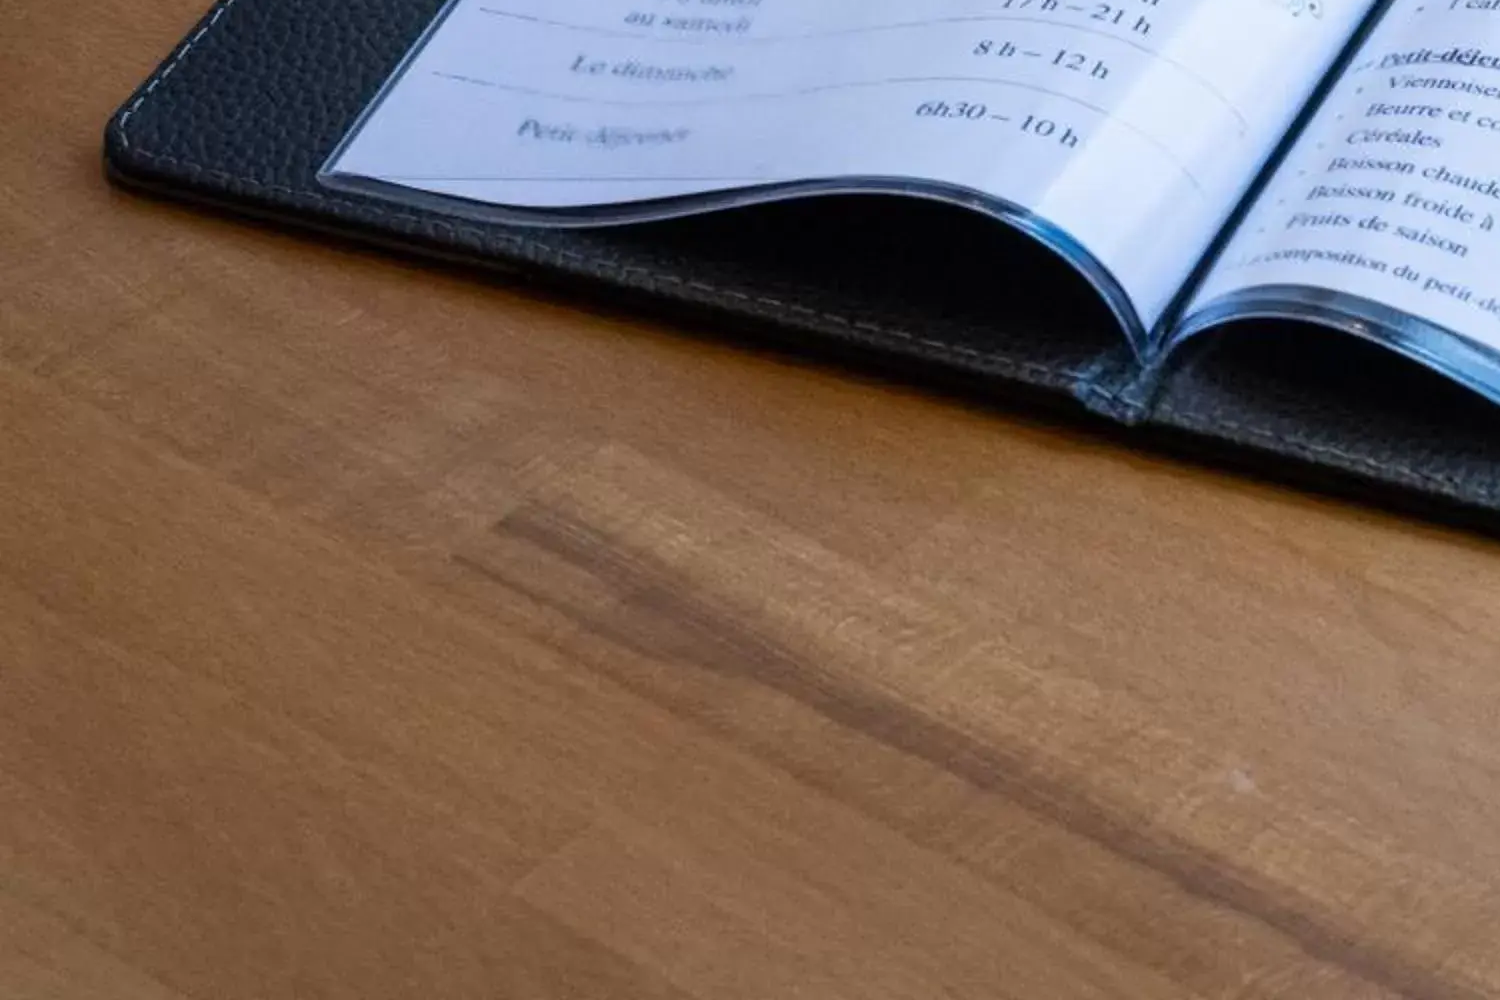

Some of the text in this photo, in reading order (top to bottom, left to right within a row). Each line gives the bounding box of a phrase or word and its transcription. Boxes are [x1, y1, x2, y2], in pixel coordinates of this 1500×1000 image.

[623, 9, 655, 28] au
[1090, 3, 1125, 26] 21
[1132, 14, 1153, 37] h
[568, 52, 608, 77] Le
[973, 40, 1111, 81] 8 h 12 h
[914, 99, 1080, 149] 6h30 10 h
[1365, 102, 1443, 119] Beurre
[1447, 108, 1473, 124] et
[1345, 127, 1446, 150] Céréales
[1327, 155, 1417, 176] Boisson
[1305, 184, 1396, 203] Boisson
[1401, 191, 1475, 225] froide
[1479, 213, 1496, 233] à
[1285, 211, 1470, 260] Fruits de saison
[1392, 264, 1420, 283] du
